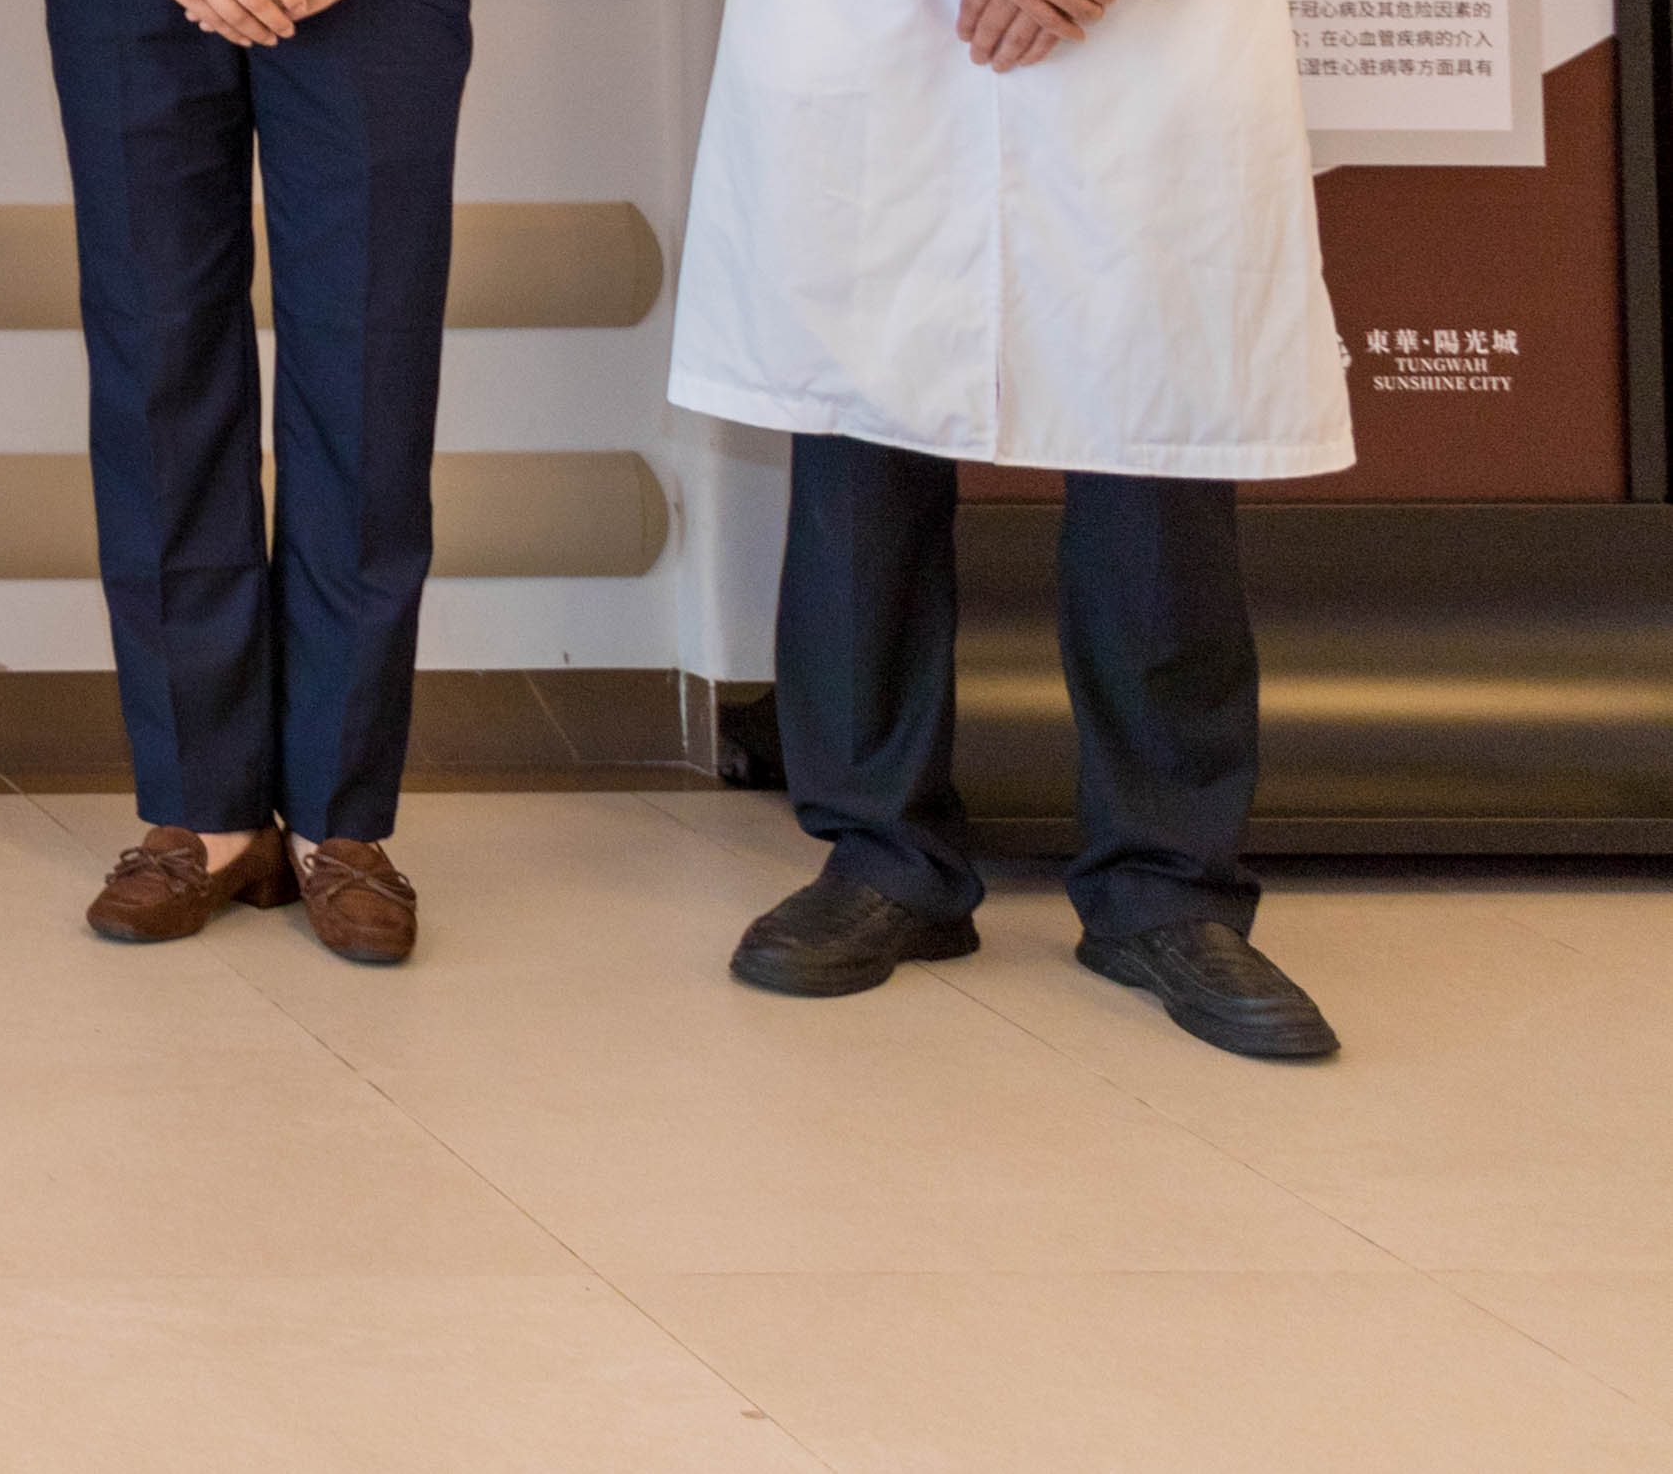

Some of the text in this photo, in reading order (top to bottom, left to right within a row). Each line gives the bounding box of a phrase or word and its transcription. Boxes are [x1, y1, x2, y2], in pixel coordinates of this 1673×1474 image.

[1394, 357, 1488, 373] TUNGWAH
[1373, 376, 1512, 391] SUNSHINE CITY
